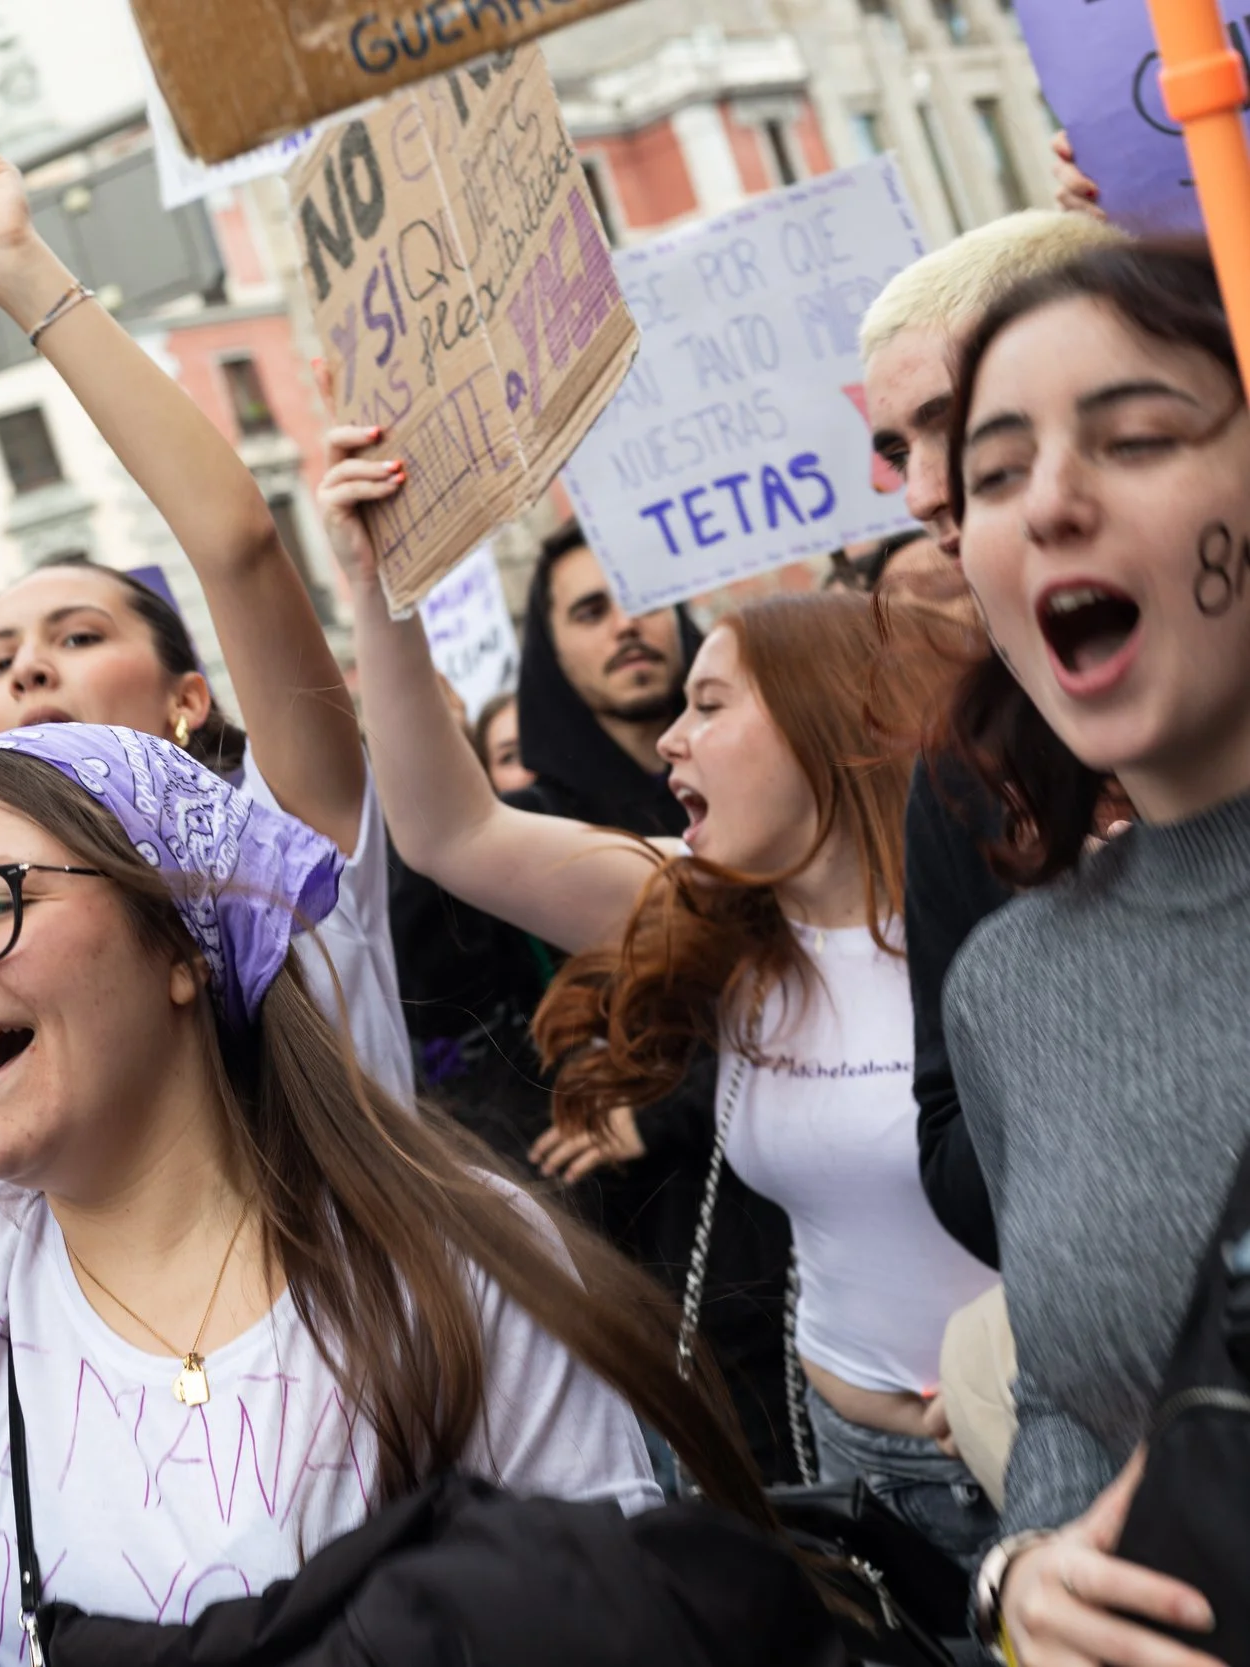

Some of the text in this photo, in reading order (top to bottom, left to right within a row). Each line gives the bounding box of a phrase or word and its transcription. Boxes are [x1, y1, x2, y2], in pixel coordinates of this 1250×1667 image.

[349, 0, 573, 76] GUER
[301, 117, 386, 303] NO
[330, 303, 358, 406] Y
[398, 78, 542, 301] QUIERES
[420, 116, 575, 387] flexibilidad
[694, 236, 767, 304] POR
[673, 312, 781, 388] TANTO
[797, 264, 904, 360] MIE
[505, 369, 528, 413] a
[608, 387, 788, 491] NUESTRAS
[638, 451, 837, 557] TETAS
